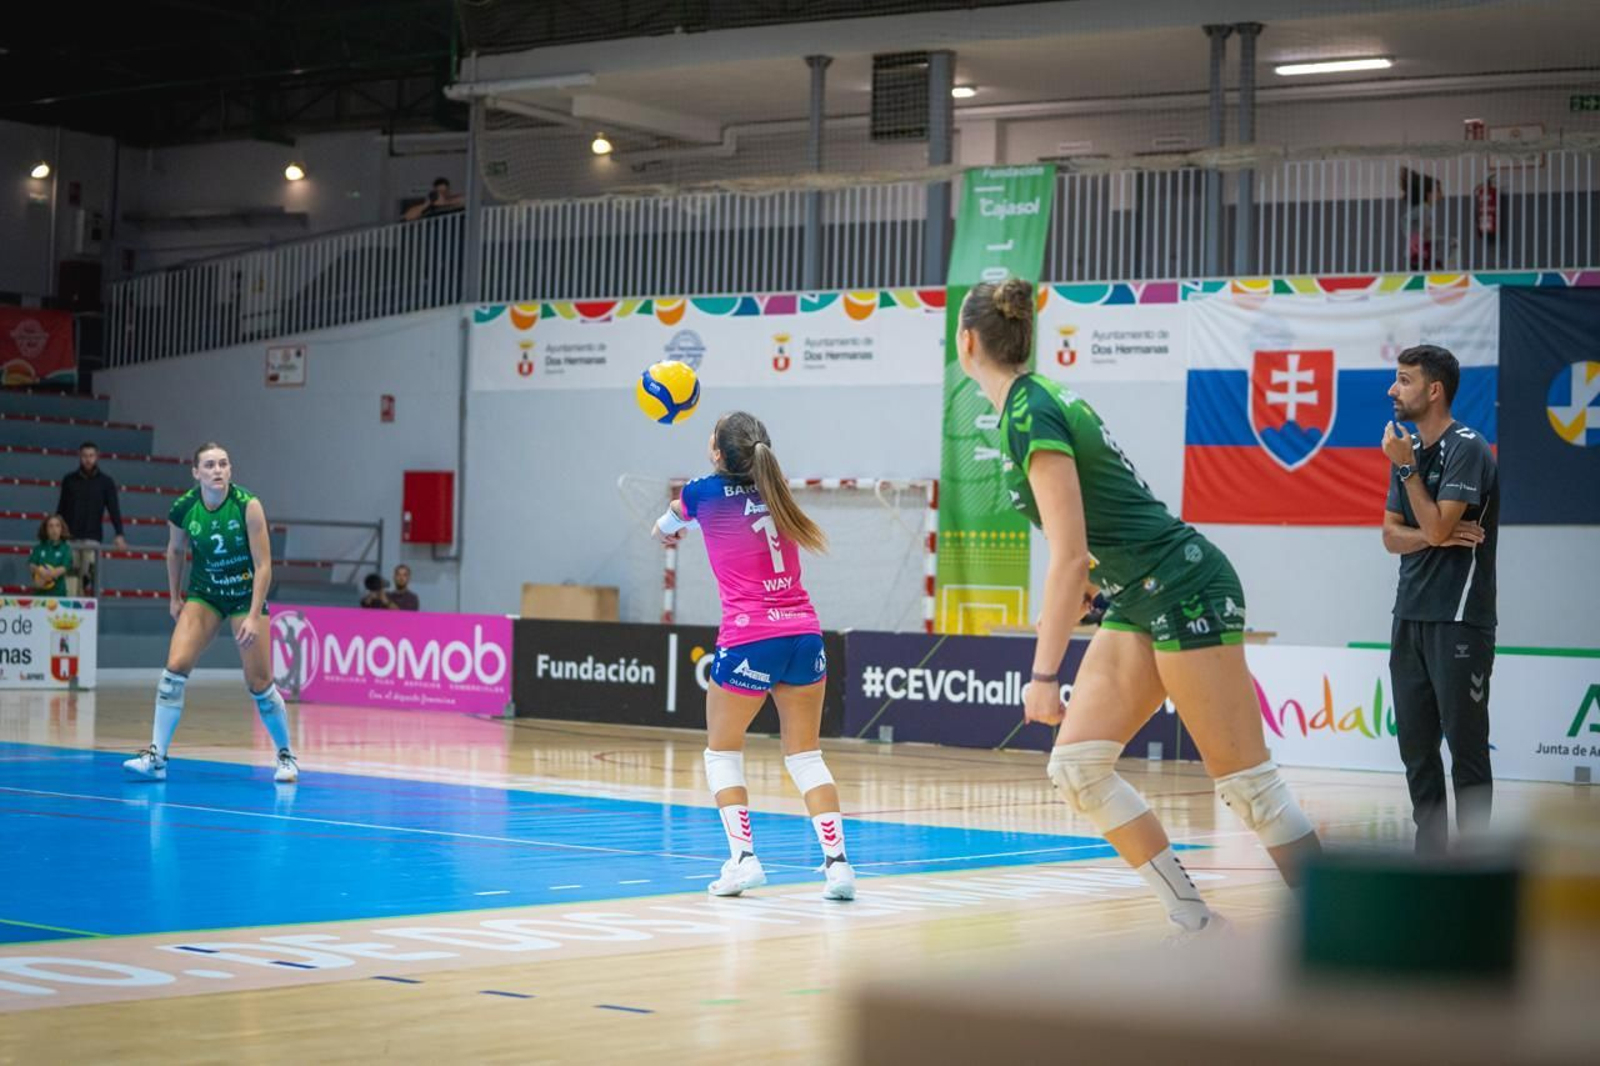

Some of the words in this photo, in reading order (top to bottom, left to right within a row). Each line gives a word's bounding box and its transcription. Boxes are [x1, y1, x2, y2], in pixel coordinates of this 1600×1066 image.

[1158, 328, 1169, 339] de
[804, 351, 822, 361] Dos
[825, 350, 873, 361] Hermanas
[1091, 343, 1112, 355] Dos
[1115, 342, 1169, 355] Hermanas
[210, 533, 227, 554] 2
[751, 515, 785, 574] 1
[762, 576, 793, 592] WAY
[11, 614, 32, 635] de
[1186, 617, 1210, 635] 10
[536, 653, 656, 685] Fundación
[1535, 742, 1570, 756] Junta
[1571, 744, 1587, 757] de
